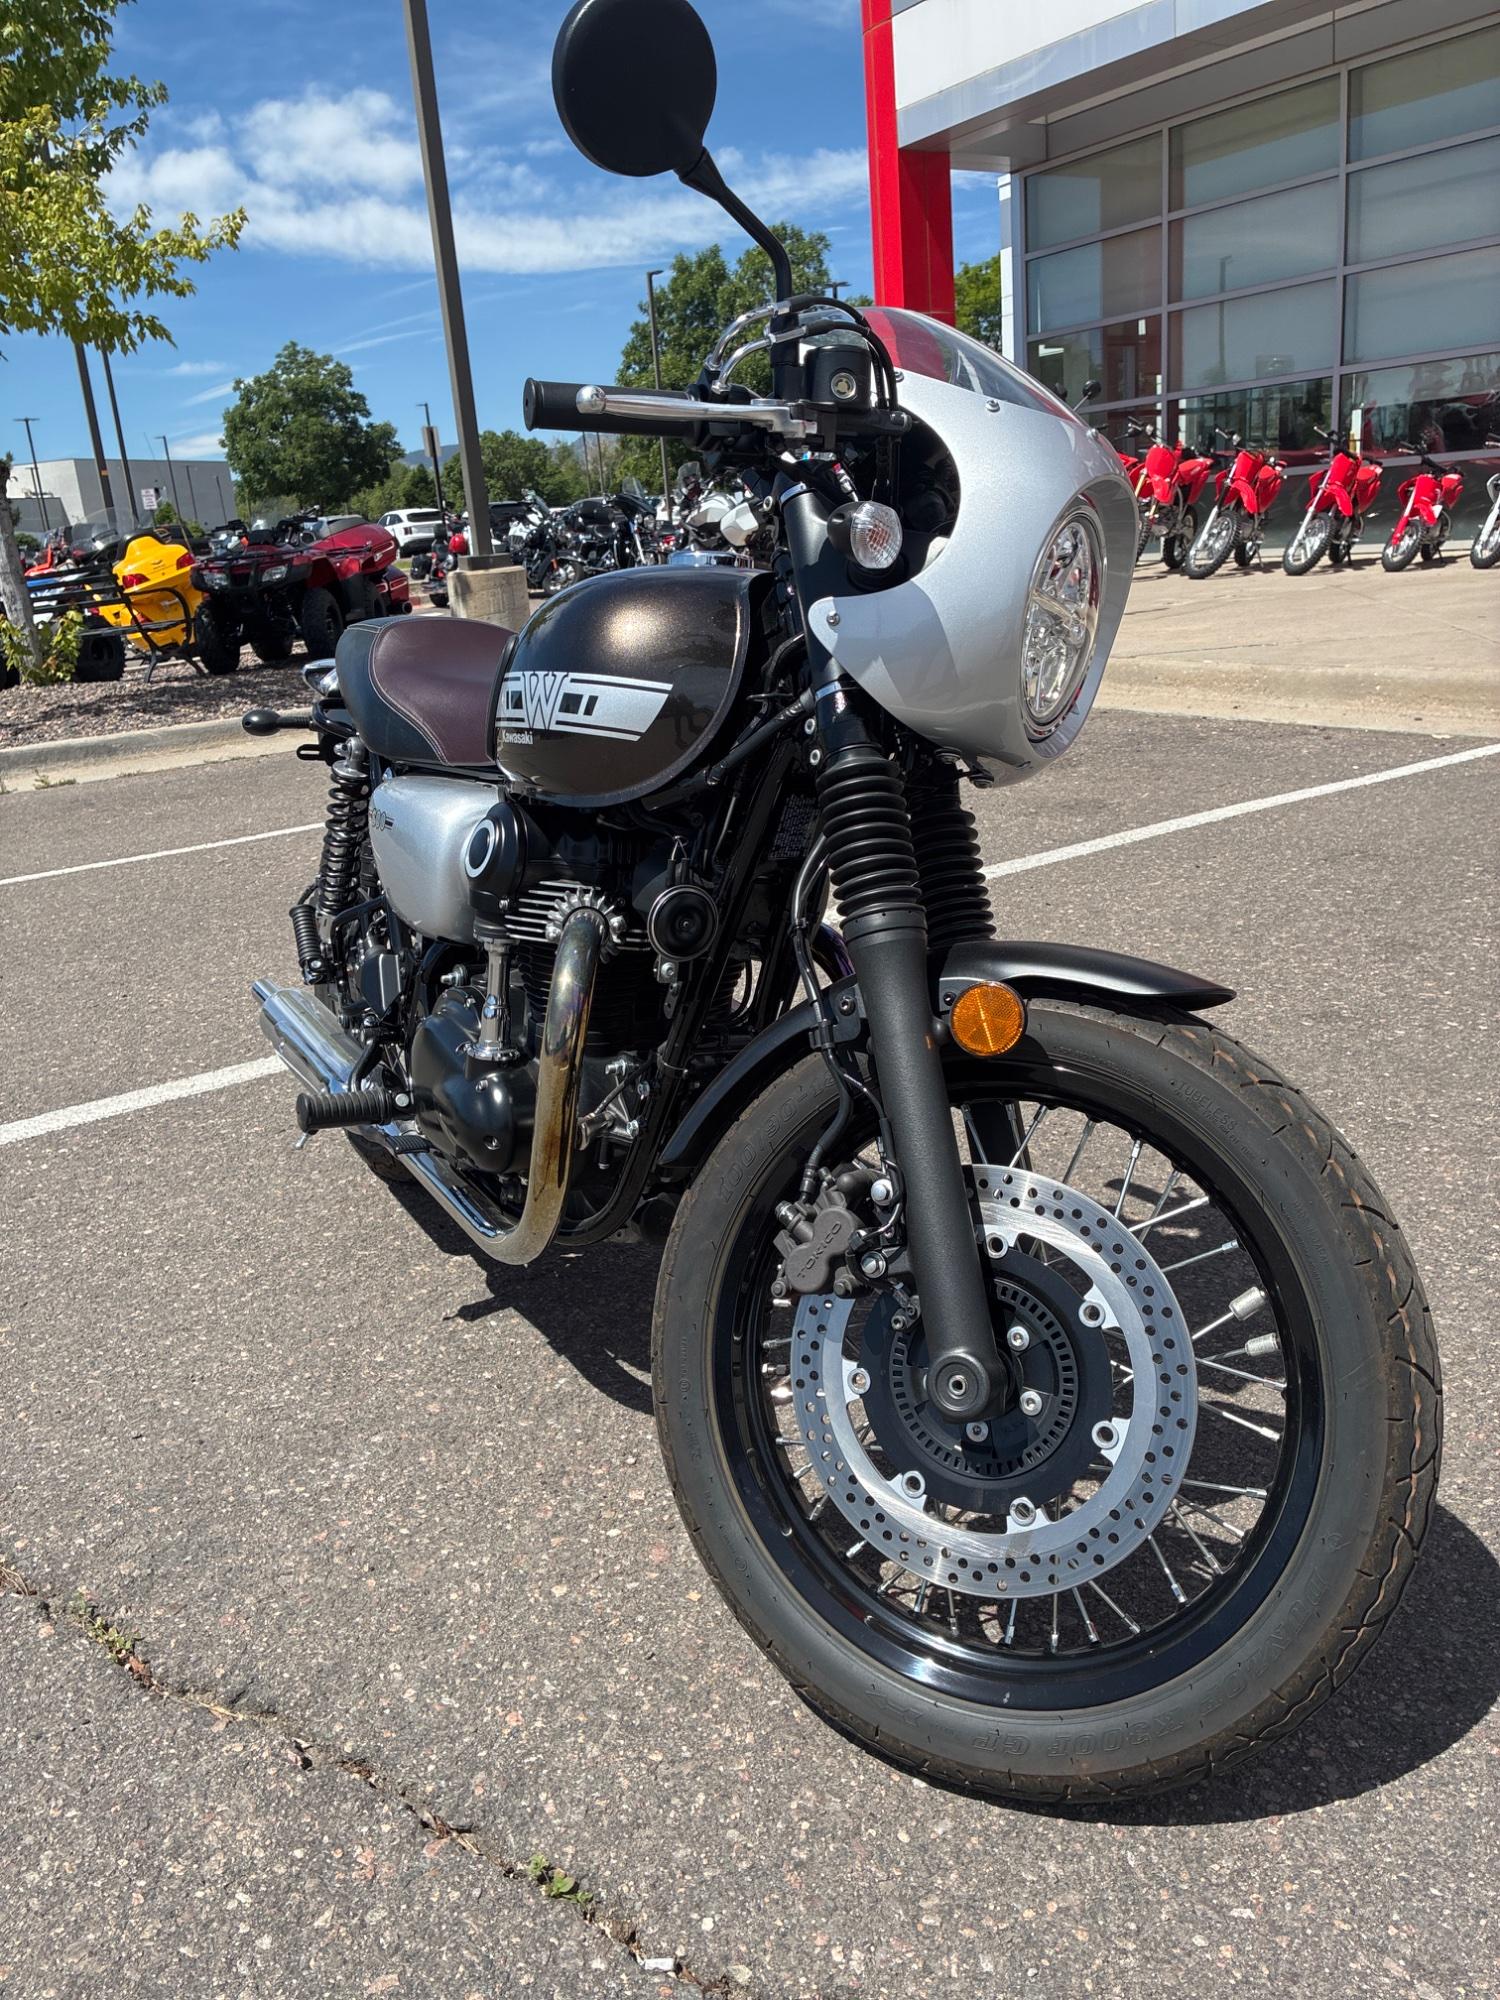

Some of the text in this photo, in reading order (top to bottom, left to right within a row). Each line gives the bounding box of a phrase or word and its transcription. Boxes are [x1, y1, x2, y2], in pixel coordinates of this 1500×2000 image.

[521, 670, 569, 731] W
[501, 728, 533, 745] Kawasaki
[1179, 1080, 1238, 1132] TUBELESS
[796, 1220, 843, 1280] TOKICO
[972, 1729, 1031, 1756] GP
[1048, 1706, 1185, 1758] K300F
